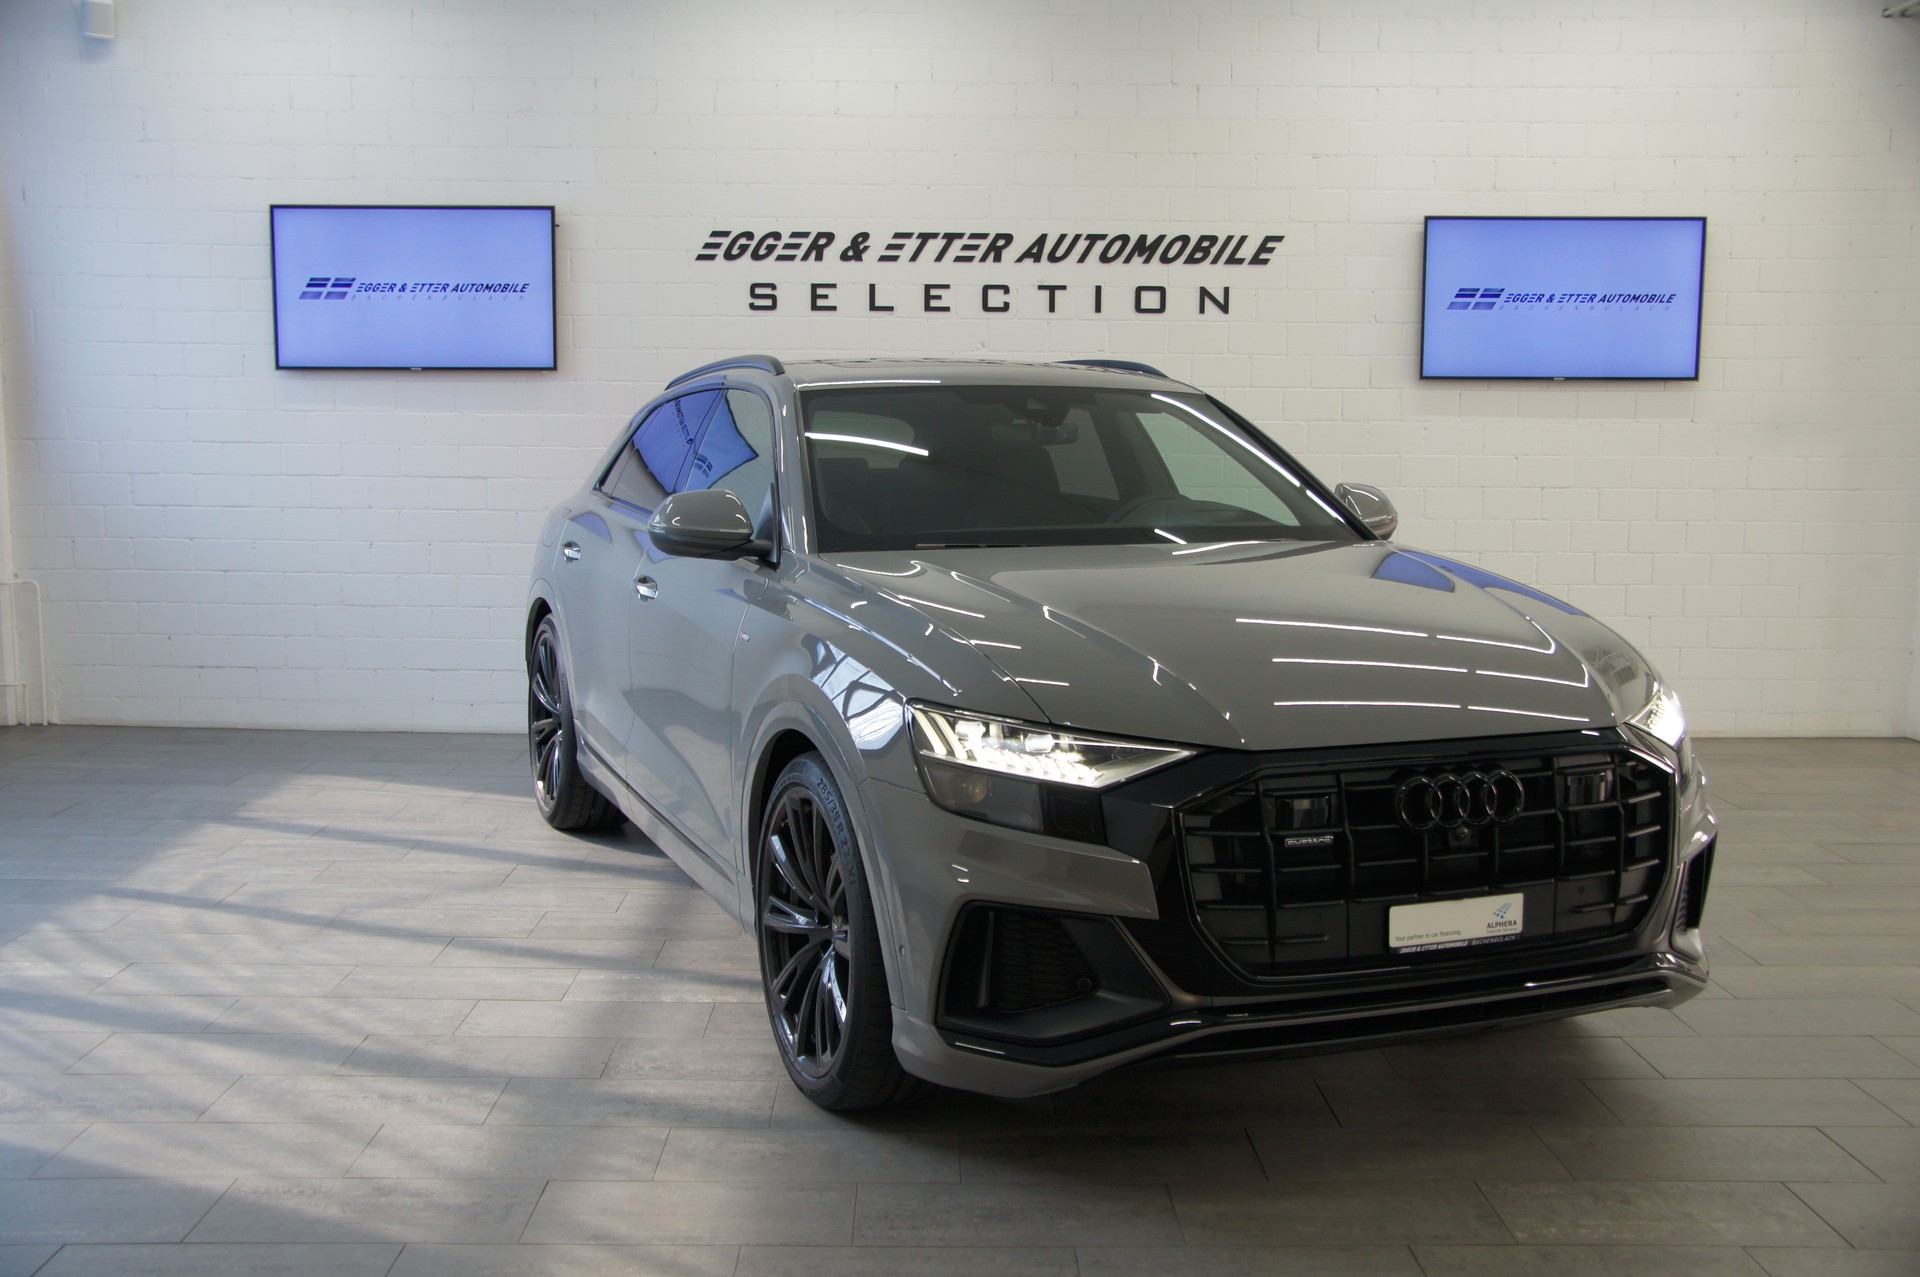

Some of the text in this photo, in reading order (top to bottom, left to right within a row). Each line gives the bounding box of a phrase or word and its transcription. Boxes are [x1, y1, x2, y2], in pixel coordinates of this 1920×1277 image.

[696, 230, 1284, 266] EGGER & ETTER AUTOMOBILE
[356, 282, 530, 294] EGGER & ETTER AUTOMOBILE
[749, 282, 1230, 315] SELECTION
[1504, 293, 1677, 304] EGGER & ETTER AUTOMOBILE
[817, 778, 841, 821] 285/35
[836, 822, 845, 835] R
[840, 836, 851, 858] 23
[1487, 920, 1517, 929] ALPHERA
